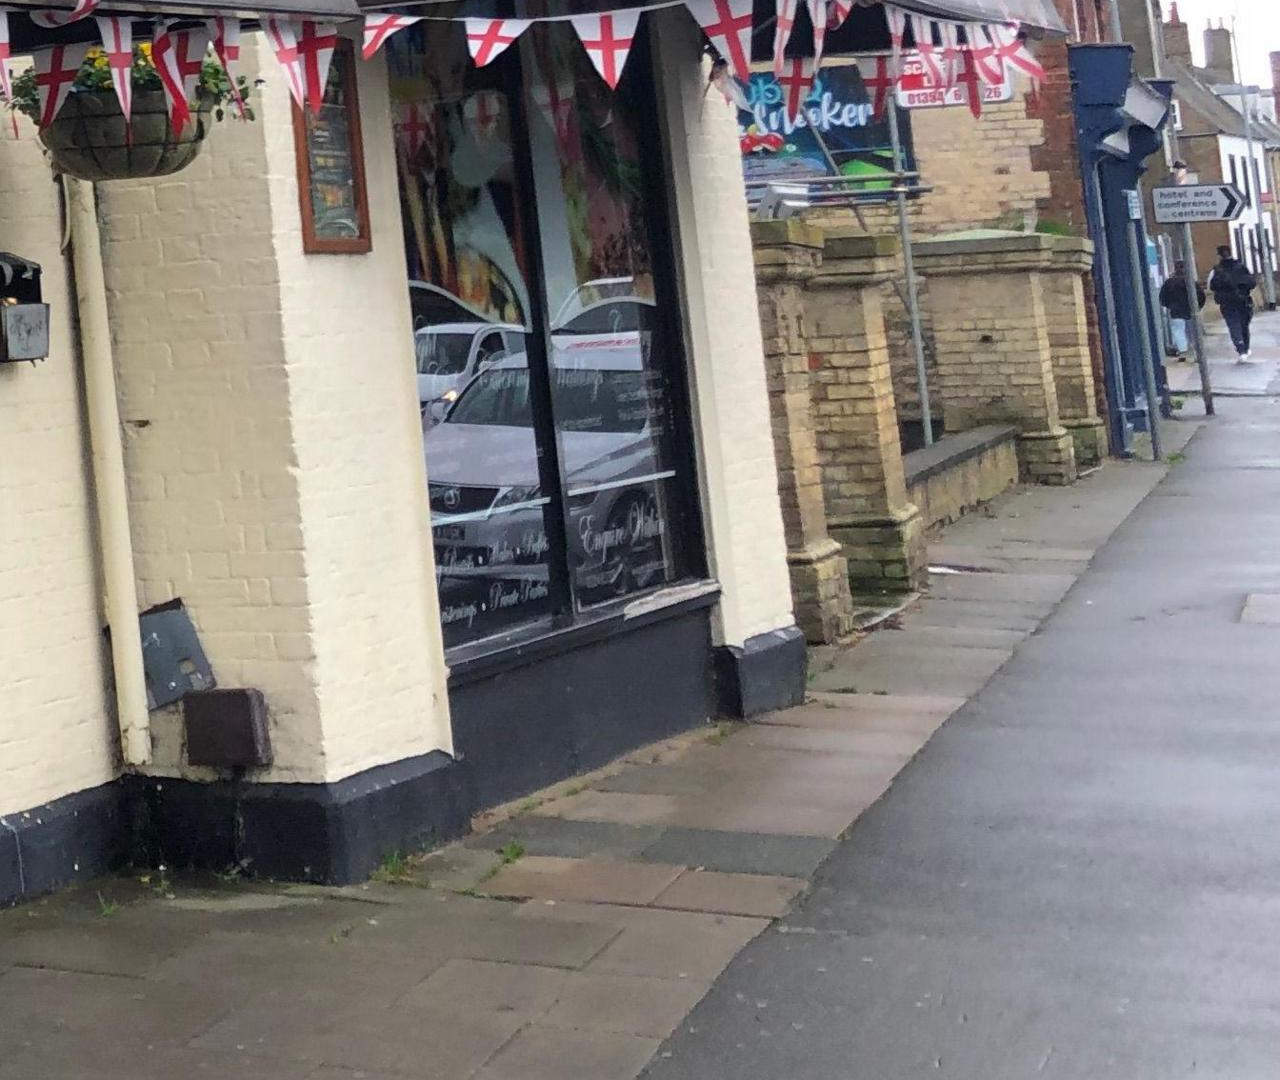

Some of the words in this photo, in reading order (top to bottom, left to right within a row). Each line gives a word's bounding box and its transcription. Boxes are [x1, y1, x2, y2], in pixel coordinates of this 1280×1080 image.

[1160, 190, 1188, 199] hotel
[1193, 189, 1213, 198] and
[1158, 200, 1217, 210] conference
